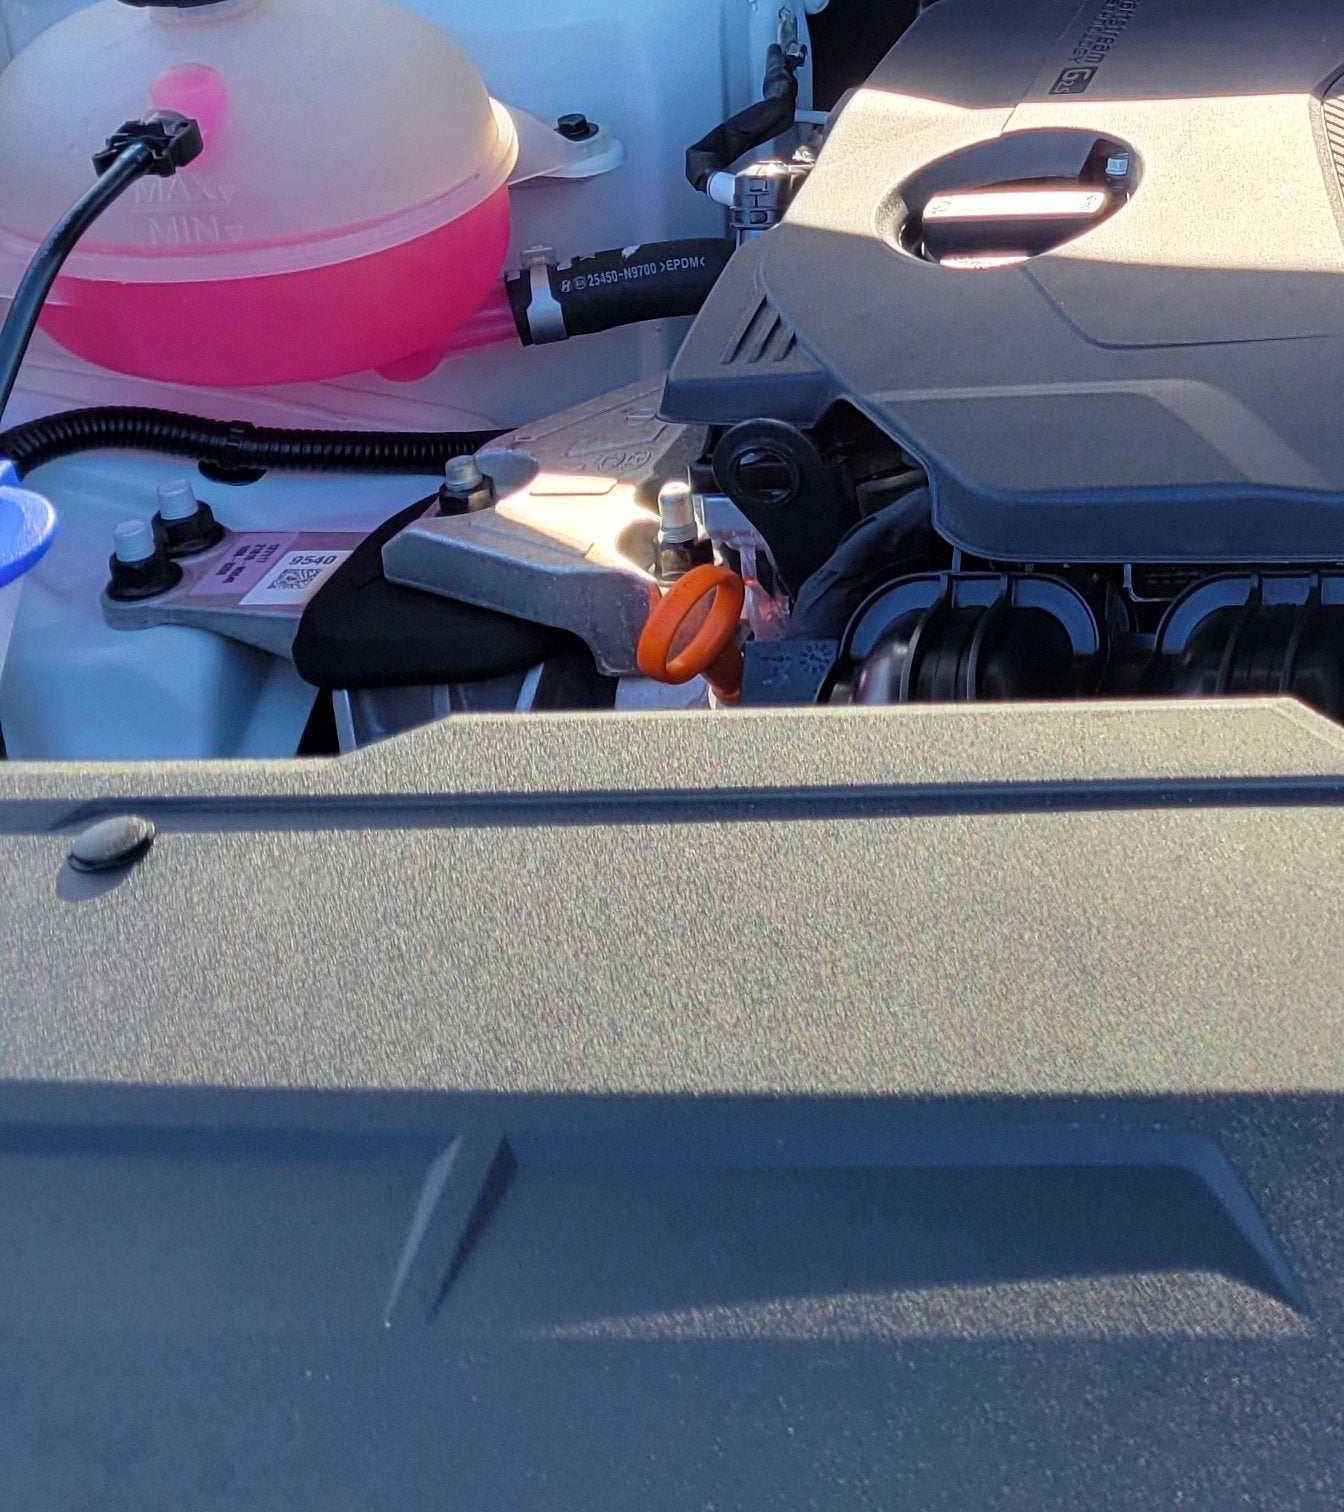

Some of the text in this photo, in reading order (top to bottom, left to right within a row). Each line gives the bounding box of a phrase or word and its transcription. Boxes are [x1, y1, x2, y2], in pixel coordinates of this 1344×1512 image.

[146, 215, 220, 245] MIN
[587, 262, 657, 287] 25450-N9700
[289, 554, 337, 565] 9540
